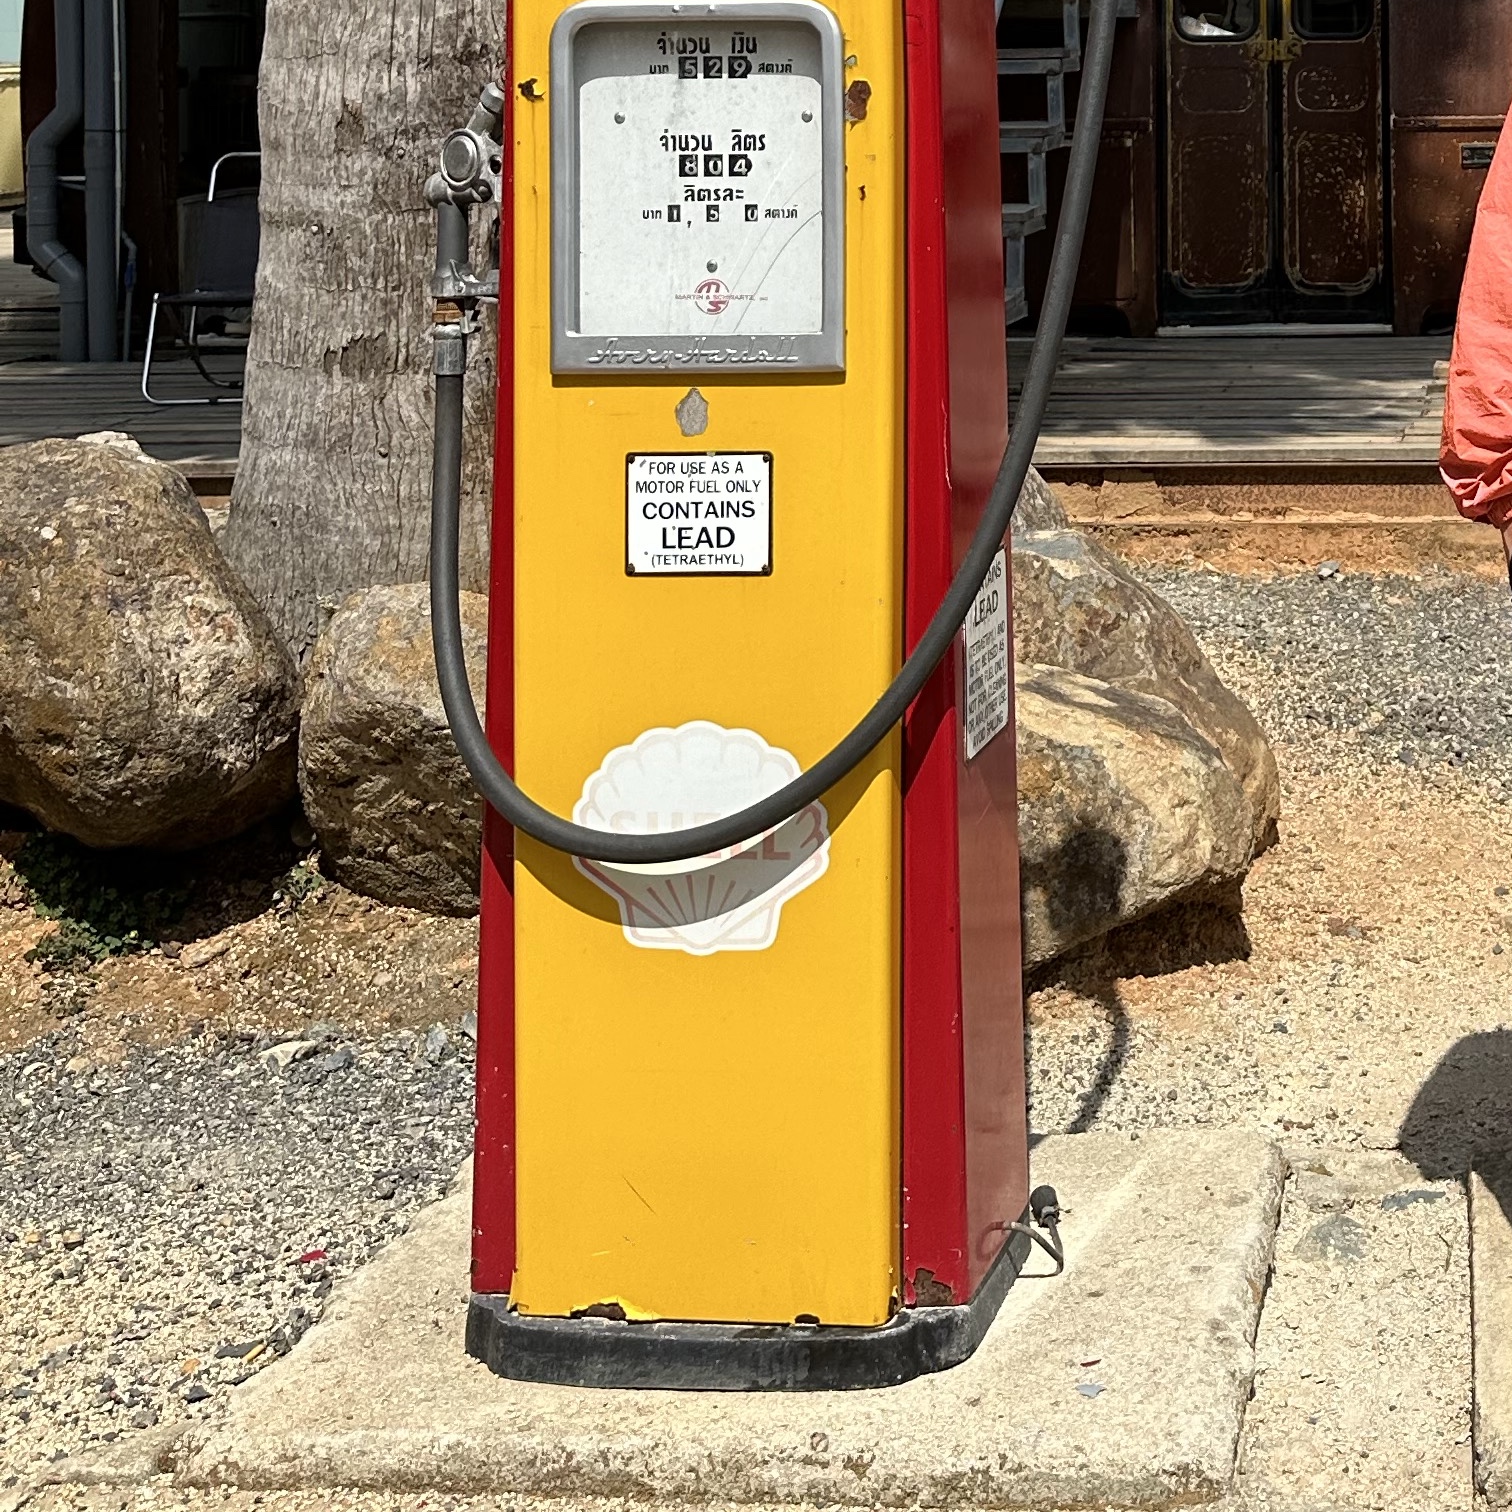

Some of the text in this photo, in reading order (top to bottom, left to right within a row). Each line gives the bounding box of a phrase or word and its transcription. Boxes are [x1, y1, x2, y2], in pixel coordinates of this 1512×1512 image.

[657, 32, 710, 54] จำนวน
[659, 129, 766, 152] จำนวน ลิตร
[684, 185, 744, 201] ลิตรละ
[642, 209, 662, 220] บาท
[649, 461, 744, 475] FOR USE AS A
[636, 480, 761, 493] MOTOR FUEL ONLY
[643, 501, 755, 520] CONTAINS
[662, 526, 735, 549] LEAD
[651, 554, 744, 568] (TETRAETHYL)
[975, 589, 999, 627] LEAD
